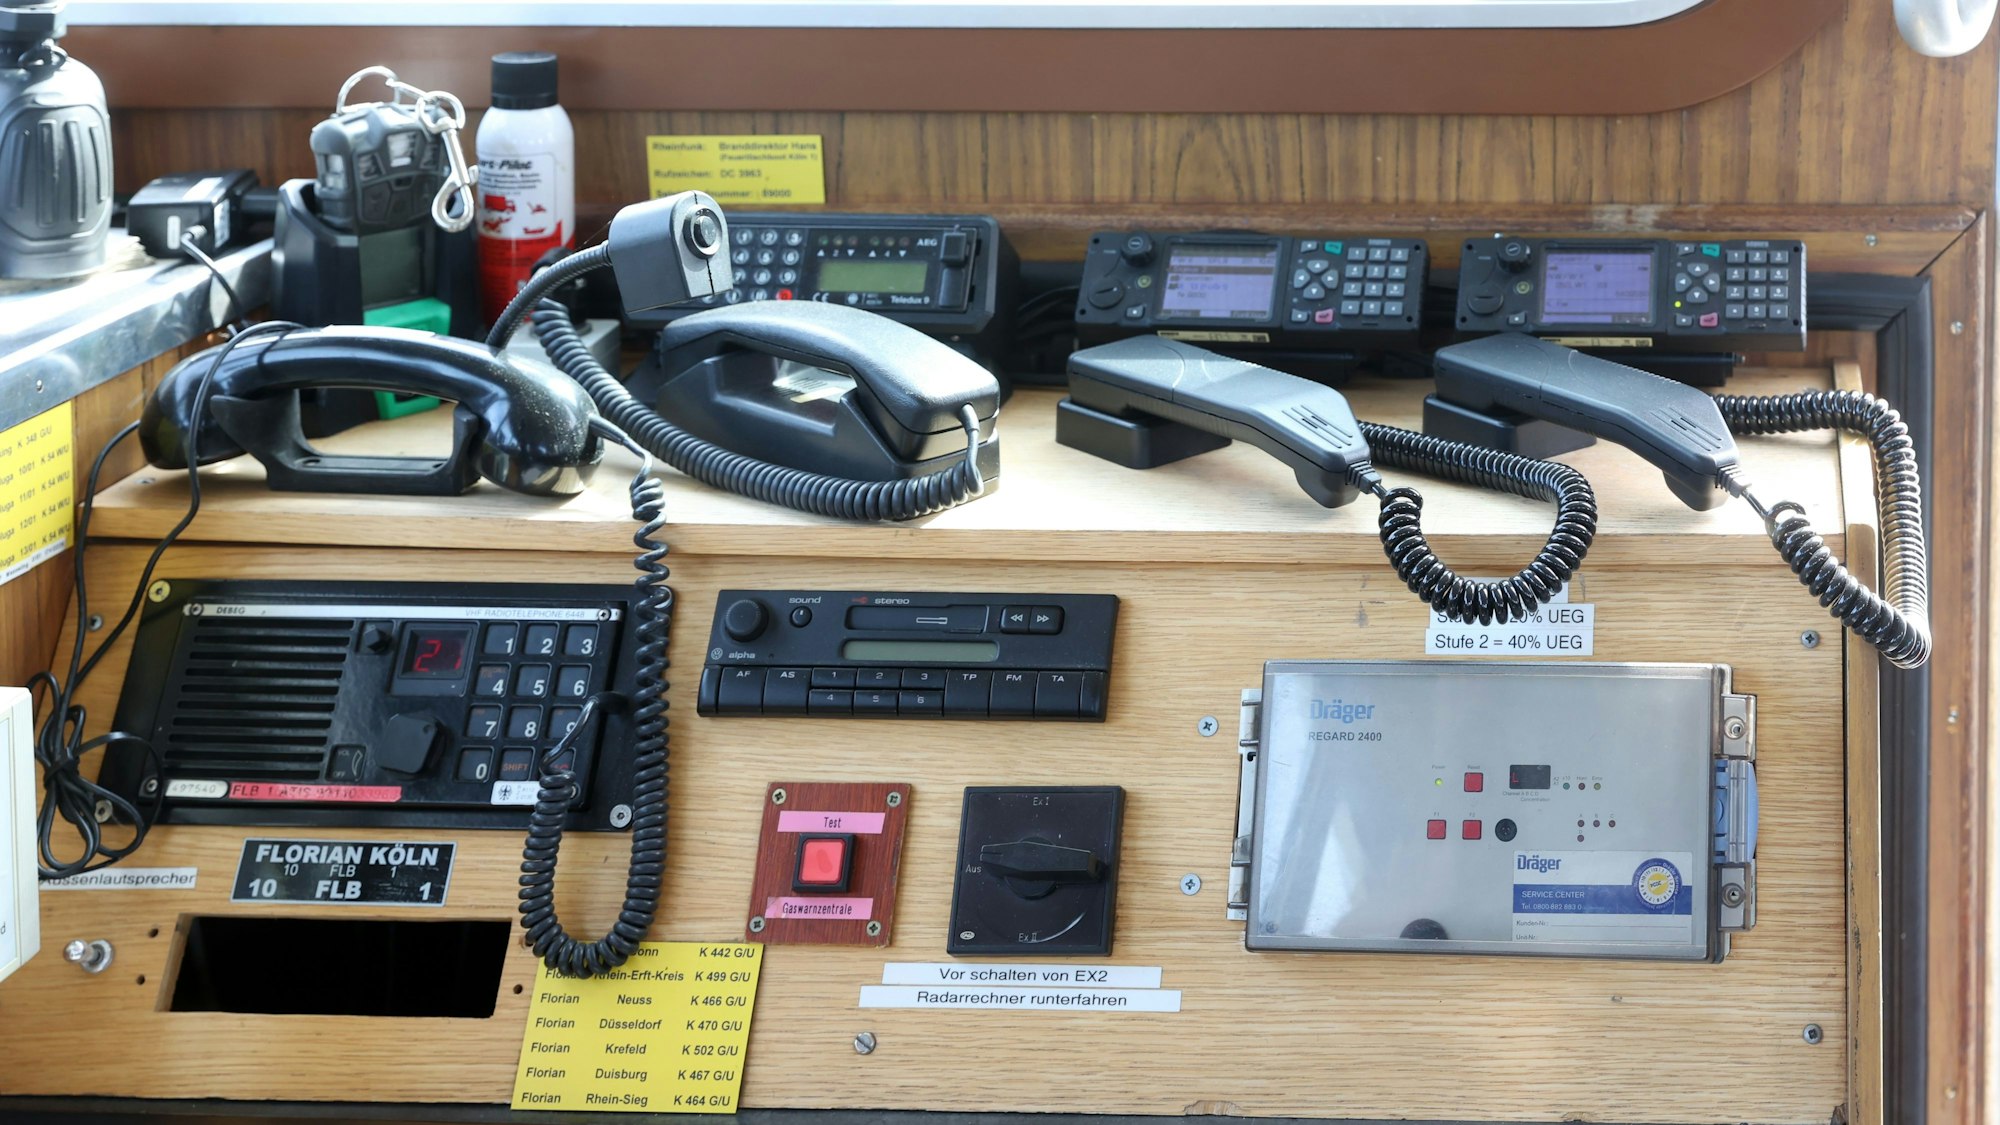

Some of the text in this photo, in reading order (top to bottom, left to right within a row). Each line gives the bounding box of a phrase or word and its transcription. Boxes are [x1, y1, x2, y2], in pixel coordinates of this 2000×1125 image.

[718, 142, 789, 151] Branddirektor
[791, 142, 817, 151] Hans
[720, 169, 735, 179] DC
[916, 237, 938, 248] AEG
[788, 595, 822, 605] sound
[874, 596, 910, 605] stereo
[215, 605, 247, 616] DEBEG
[464, 608, 586, 619] VHF RADIOTELEPHONE 6448
[1548, 608, 1585, 624] UEG
[505, 638, 593, 655] 1 2 3
[1435, 633, 1474, 649] Stufe
[1479, 634, 1489, 649] 2
[1508, 634, 1541, 650] 40%
[1546, 635, 1583, 650] UEG
[728, 650, 756, 661] alpha
[736, 670, 751, 678] AF
[780, 671, 796, 679] AS
[875, 672, 884, 680] 2
[920, 673, 928, 681] 3
[962, 673, 977, 681] TP
[1005, 674, 1023, 682] FM
[1052, 675, 1065, 683] TA
[492, 679, 585, 697] 4 5 6
[873, 695, 880, 703] 5
[917, 696, 925, 704] 6
[1310, 698, 1377, 724] Dräger
[485, 721, 497, 738] 7
[524, 721, 537, 738] 8
[1308, 731, 1382, 742] REGARD 2400
[475, 763, 530, 780] 0 SHIFT
[232, 784, 260, 797] FLB
[1032, 797, 1043, 806] Ex
[823, 816, 842, 829] Test
[255, 841, 439, 866] FLORIAN KÖLN
[965, 863, 982, 874] Aus
[1517, 853, 1562, 873] Dräger
[283, 863, 397, 878] 10 FLB 1
[248, 878, 432, 901] 10 FLB 1
[1521, 890, 1585, 899] SERVICE CENTER
[782, 902, 853, 916] Gaswarnzentrale
[1018, 932, 1029, 942] Ex
[632, 946, 755, 959] onn K 442 G/U
[695, 972, 704, 981] K
[706, 972, 726, 982] 499
[730, 972, 751, 983] G/U
[939, 966, 1109, 983] Vor schalten von EX2
[540, 993, 747, 1007] Florian Neuss K 466 G/U
[917, 990, 1127, 1007] Radarrechner runterfahren
[535, 1017, 743, 1031] Florian Düsseldorf K 470 G/U
[531, 1042, 739, 1057] Florian Krefeld K 502 G/U
[526, 1067, 735, 1082] Florian Duisburg K 467 G/U
[521, 1092, 731, 1107] Florian Rhein-Sieg K 464 G/U
